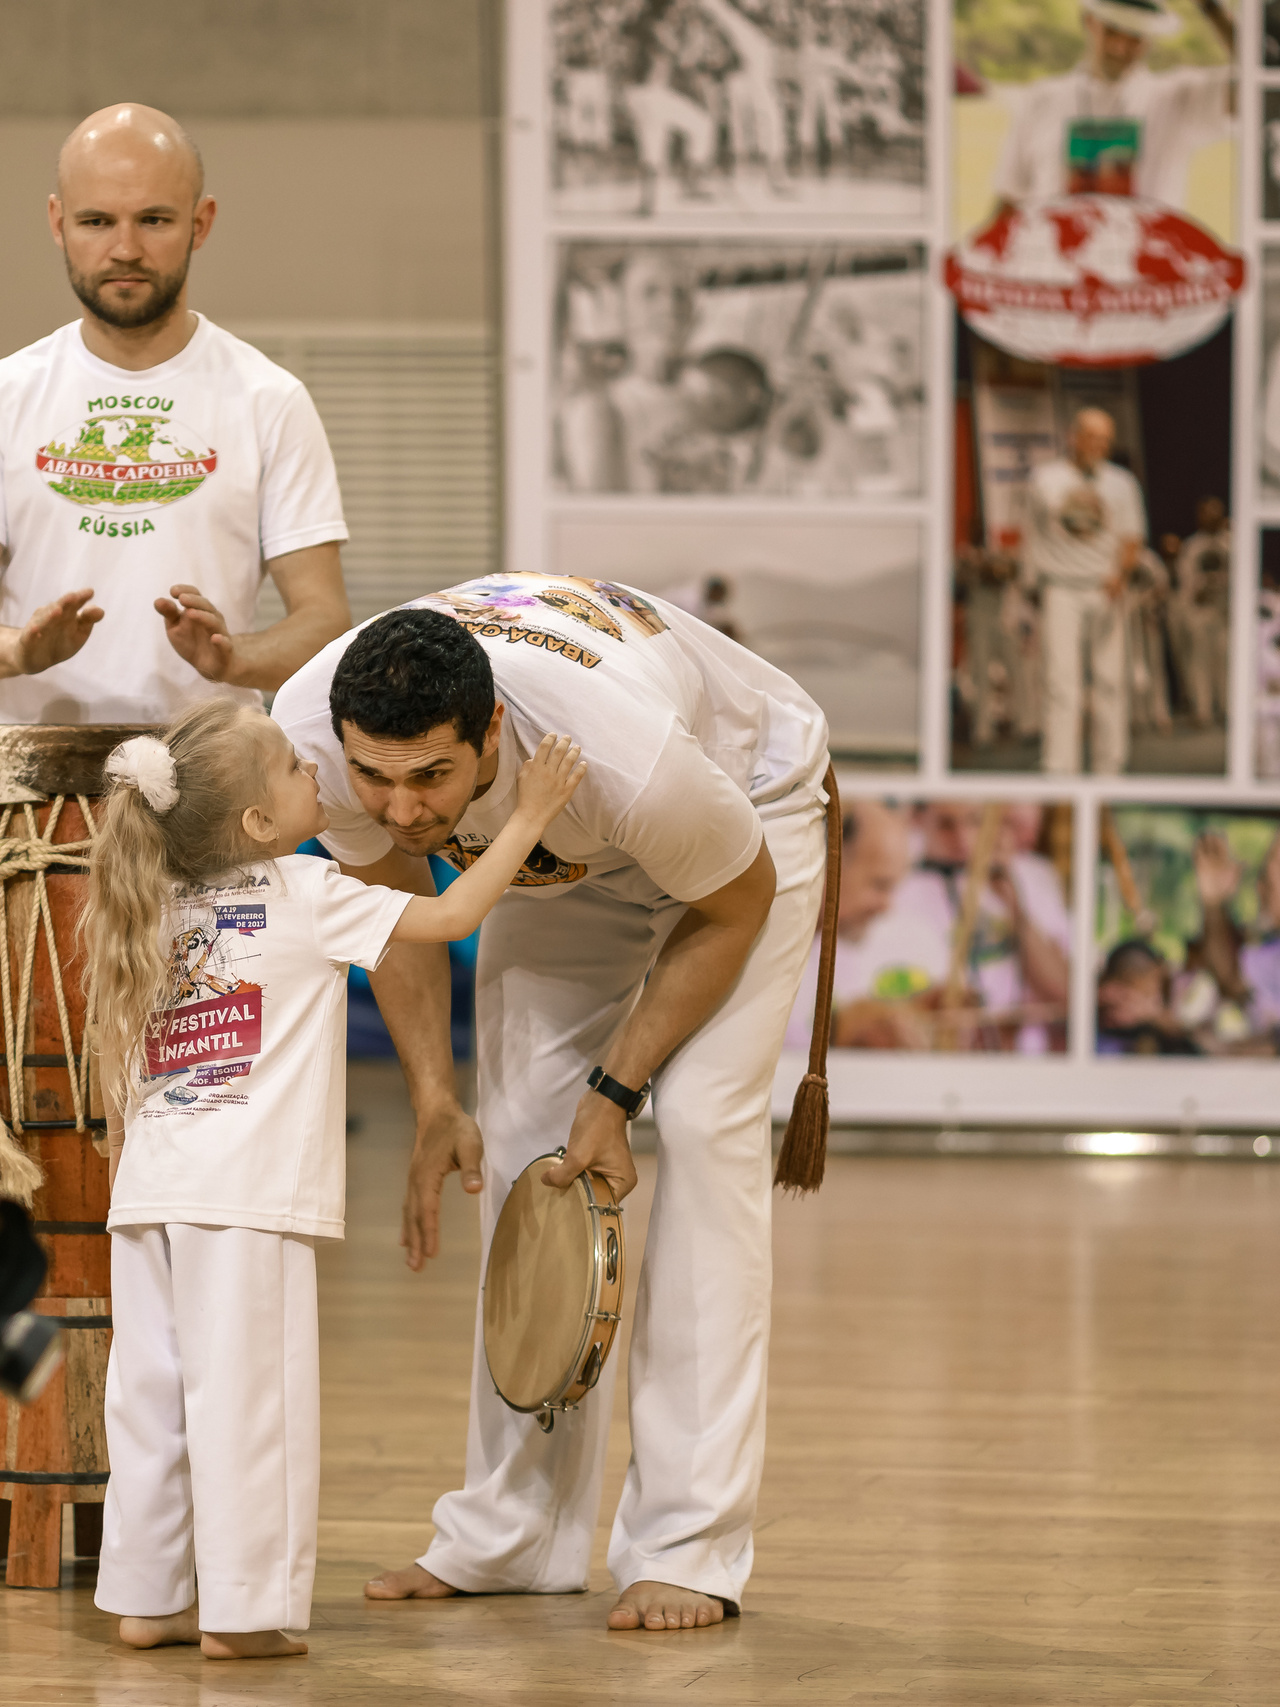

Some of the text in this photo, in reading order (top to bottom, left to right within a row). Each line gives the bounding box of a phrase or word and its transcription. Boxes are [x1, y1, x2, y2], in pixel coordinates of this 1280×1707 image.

[87, 395, 174, 412] MOSCOU
[41, 458, 209, 481] ABADÁ-CAPOEIRA
[78, 514, 155, 538] RÚSSIA
[458, 621, 601, 669] ABADÁ-CA
[170, 1004, 255, 1036] FESTIVAL
[158, 1031, 243, 1063] INFANTIL
[214, 1076, 234, 1085] BRO
